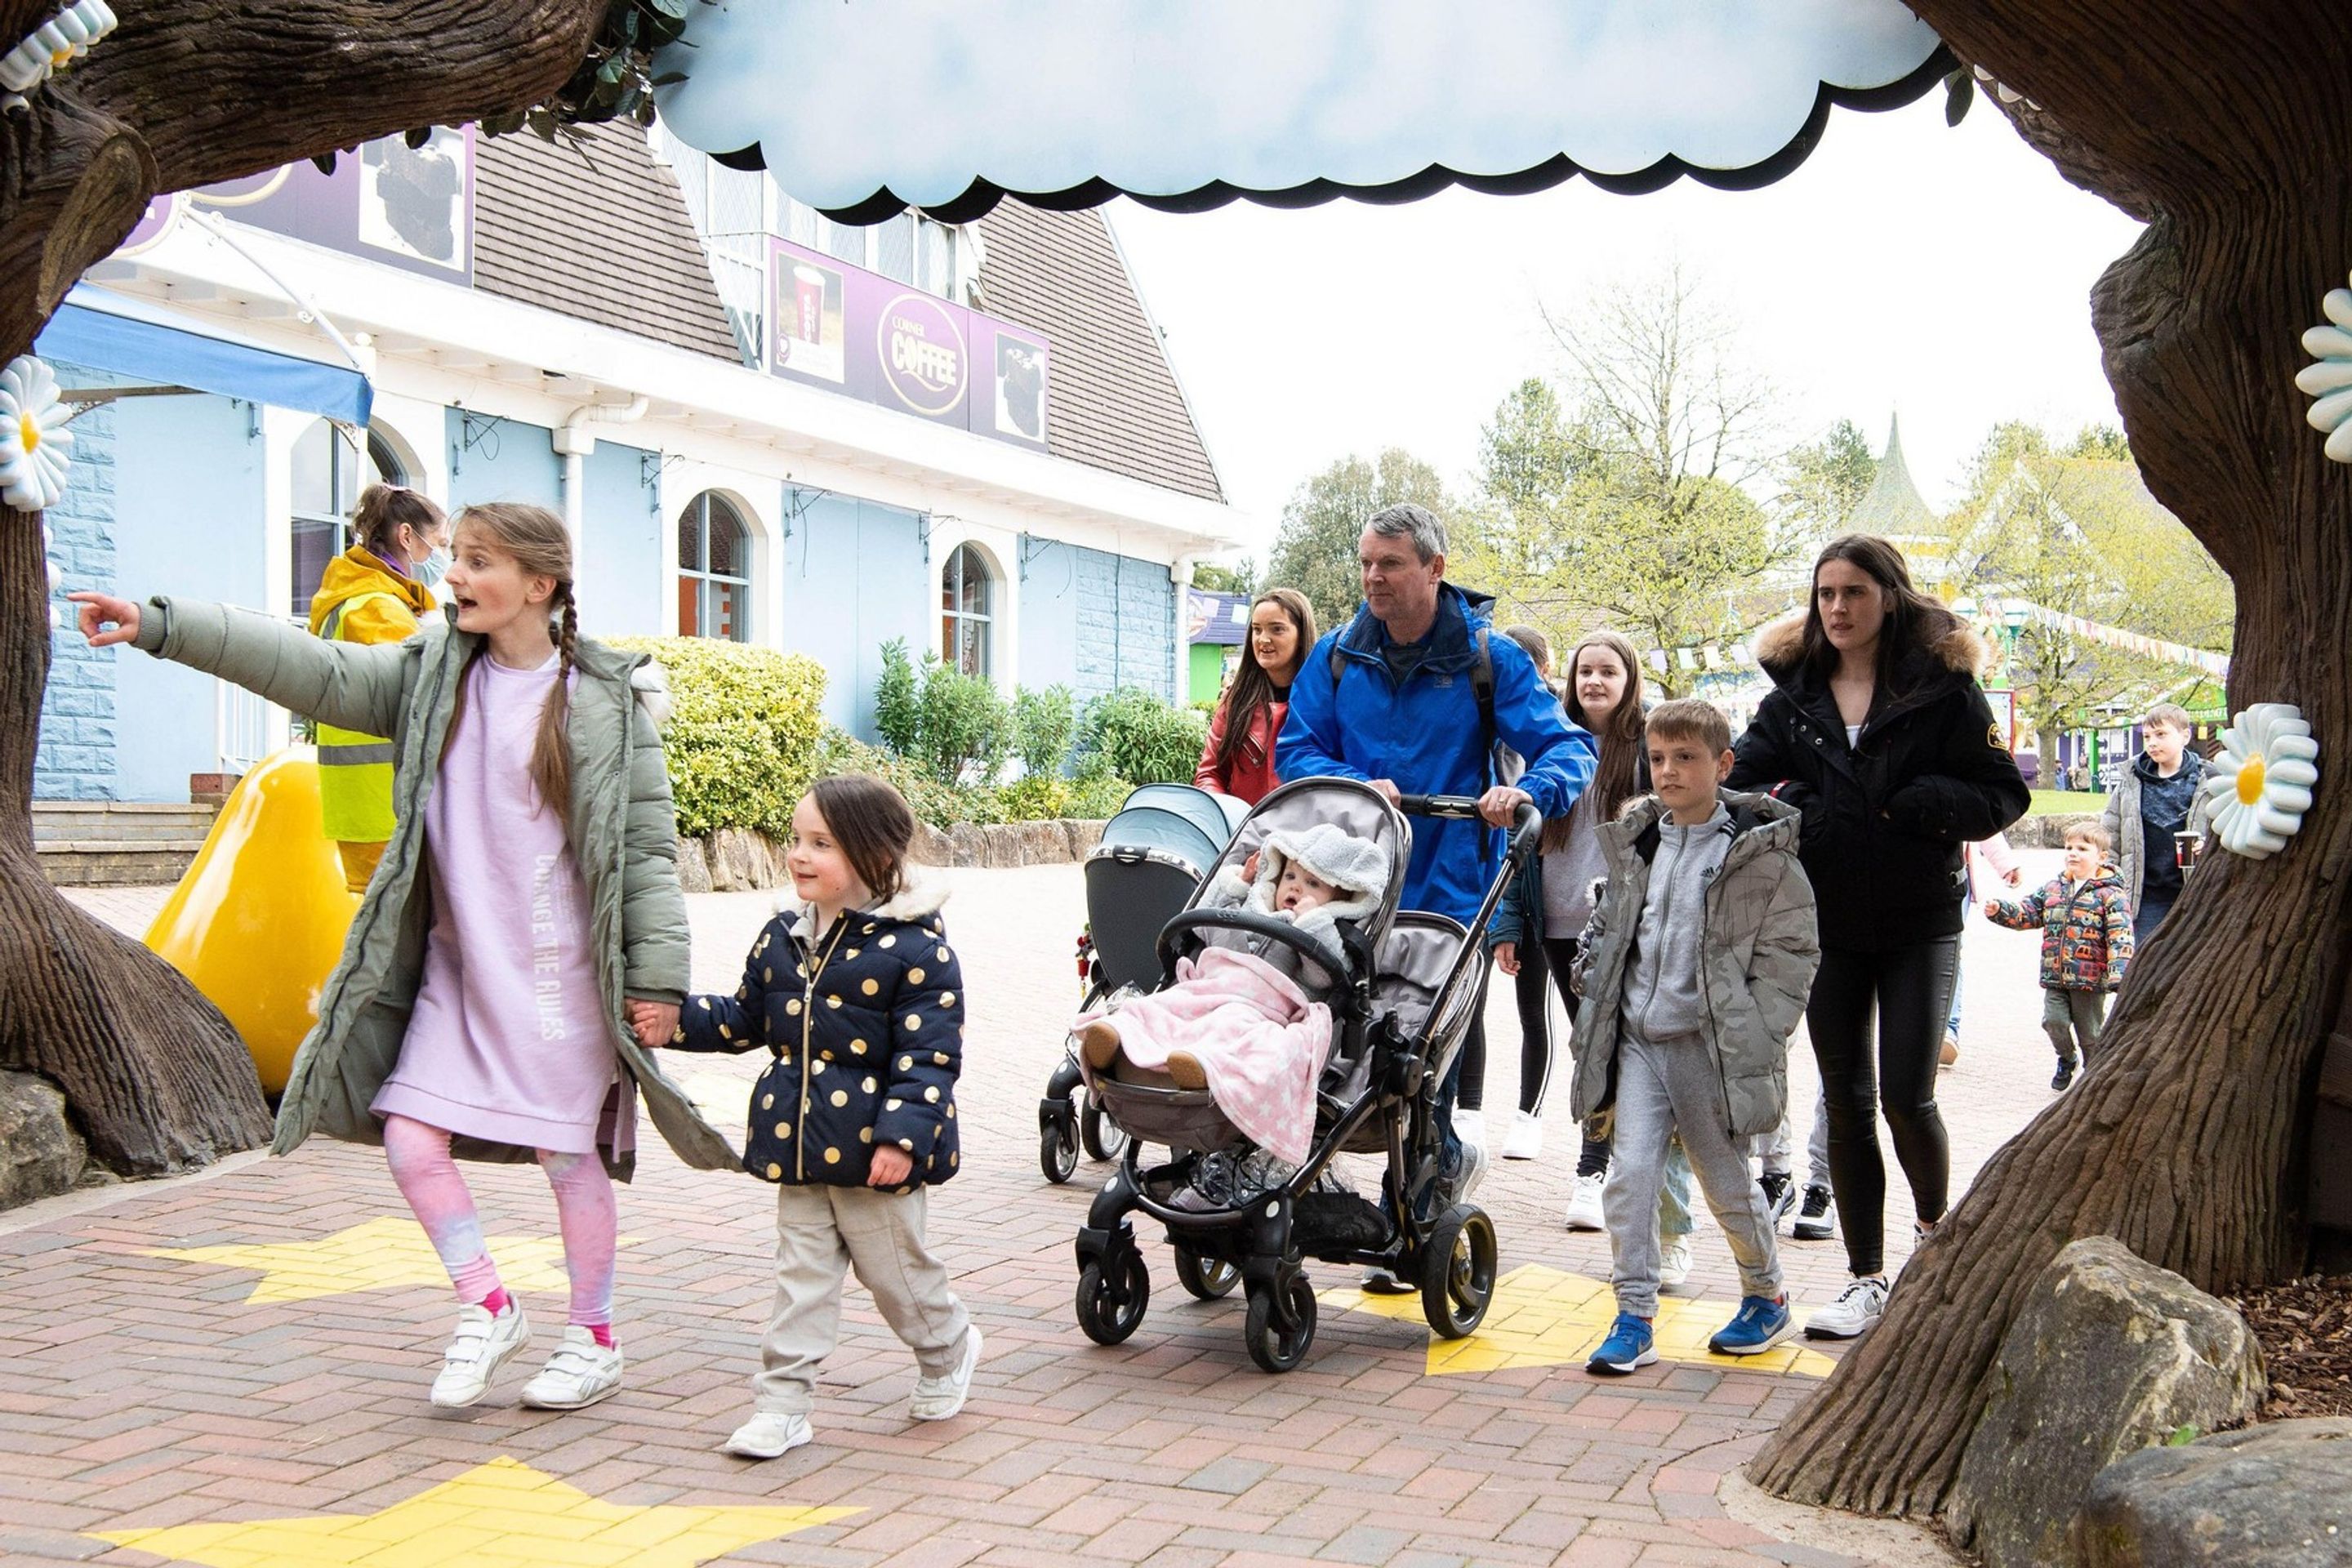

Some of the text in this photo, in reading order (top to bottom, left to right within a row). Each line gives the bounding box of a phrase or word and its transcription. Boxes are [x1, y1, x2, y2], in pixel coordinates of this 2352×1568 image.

[892, 315, 925, 337] CORNER
[891, 331, 957, 386] COFFEE
[533, 937, 559, 974] THE
[535, 980, 565, 1041] RULES
